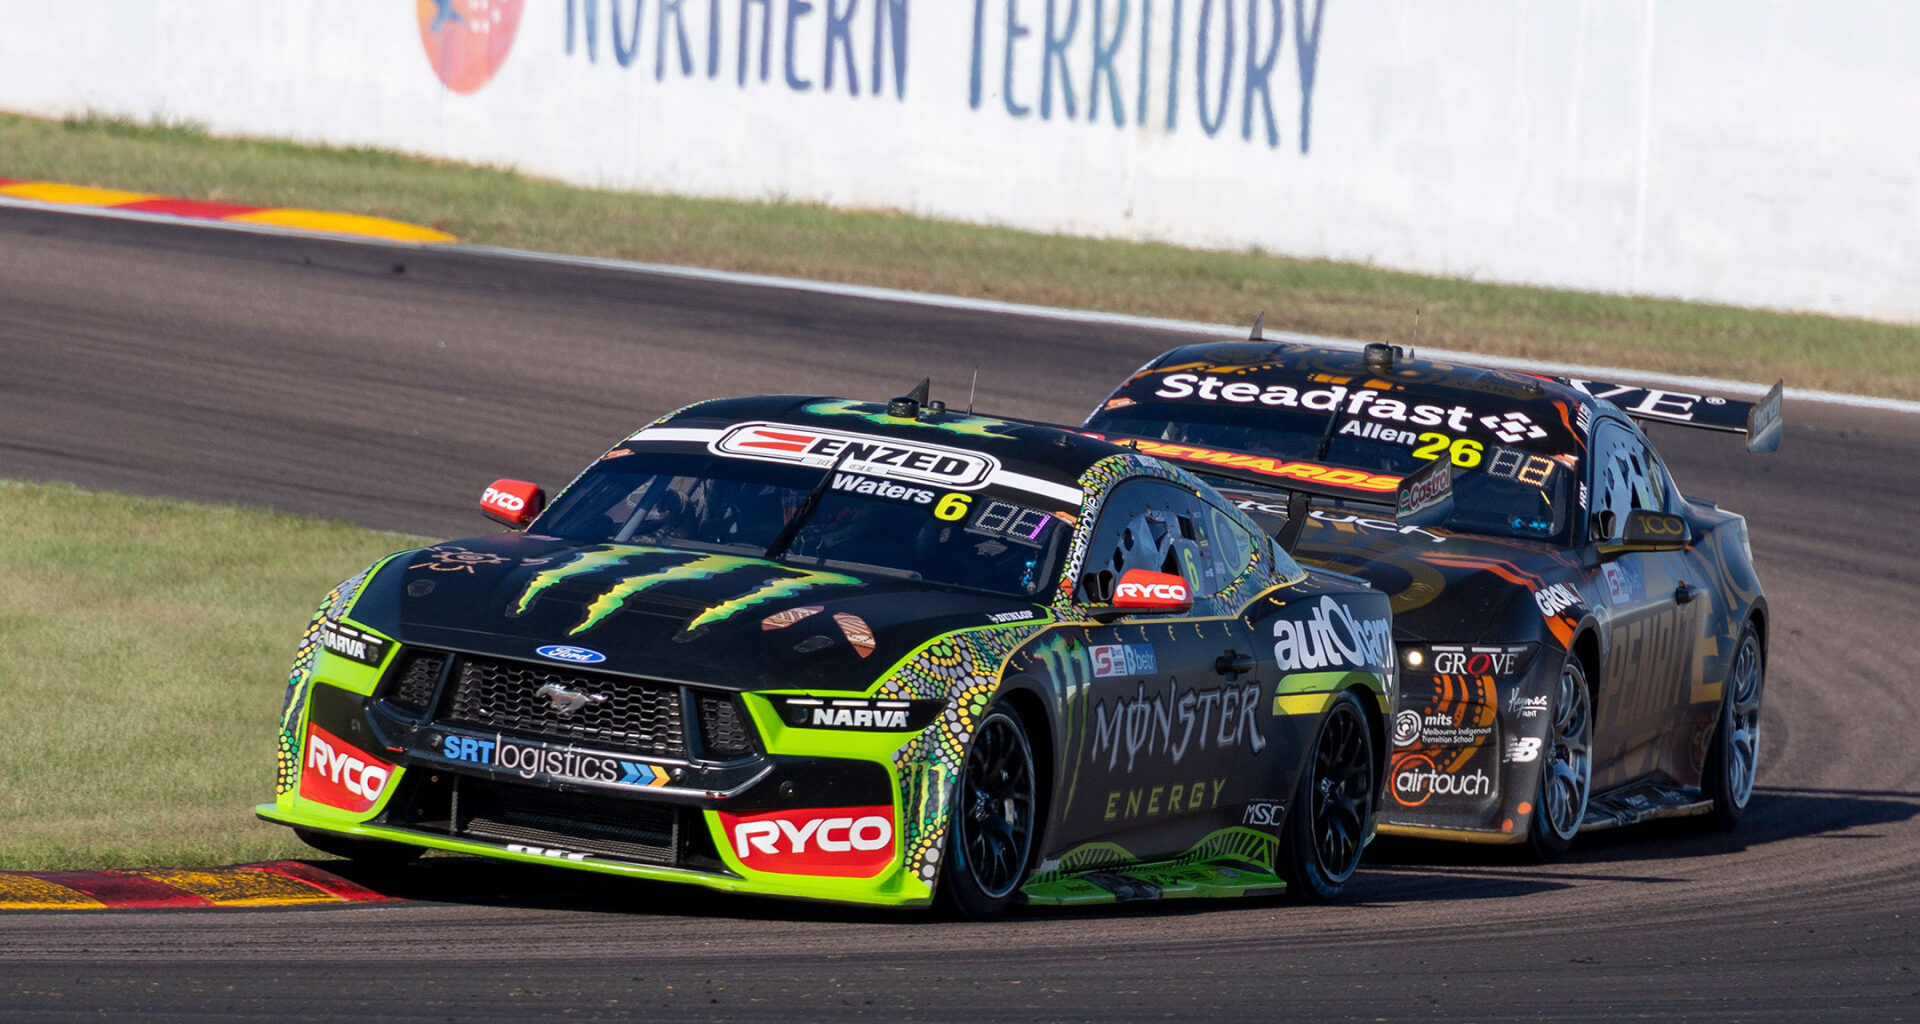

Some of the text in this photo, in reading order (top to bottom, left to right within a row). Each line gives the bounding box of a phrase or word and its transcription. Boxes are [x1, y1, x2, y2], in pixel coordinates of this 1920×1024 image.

[1155, 372, 1480, 432] Steadfast
[806, 438, 970, 477] ENZED
[1338, 419, 1484, 468] Allen 26
[482, 487, 525, 511] RYCO
[831, 473, 973, 521] Waters 6
[1409, 461, 1451, 511] Castrol
[1183, 548, 1200, 592] 6
[1116, 582, 1187, 601] RYCO
[548, 647, 594, 660] Ford
[1434, 652, 1515, 675] GROVE
[812, 708, 908, 728] NARVA
[1424, 712, 1453, 726] mits
[1422, 727, 1492, 739] Melbourne Indigenous
[1422, 735, 1475, 744] Transition School
[308, 734, 387, 801] RYCO
[1396, 768, 1489, 796] airtouch
[1103, 778, 1227, 819] ENERGY
[1241, 803, 1285, 826] MSC
[734, 815, 893, 859] RYCO
